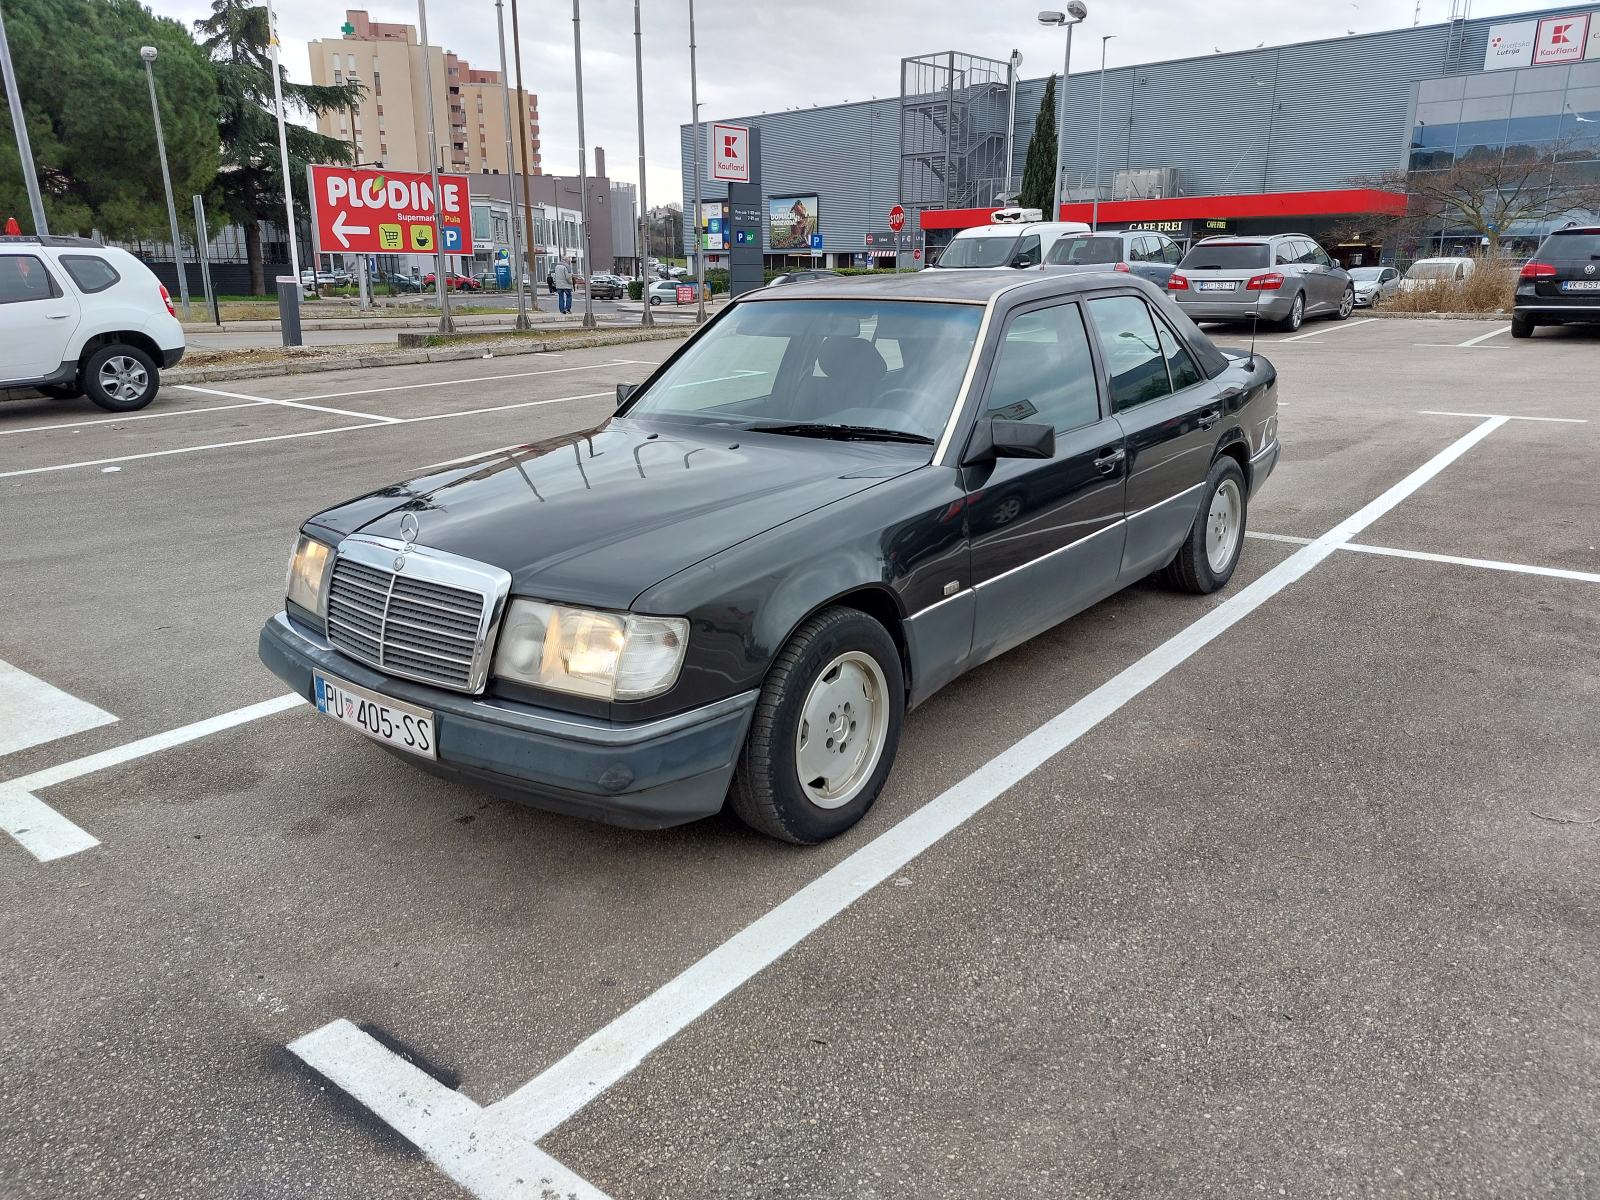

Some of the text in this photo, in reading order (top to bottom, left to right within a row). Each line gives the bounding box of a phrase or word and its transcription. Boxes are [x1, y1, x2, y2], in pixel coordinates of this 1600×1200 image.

[1499, 40, 1531, 50] Hrvatska
[1496, 48, 1520, 56] Lutrija
[1540, 46, 1578, 56] Kaufland
[717, 161, 745, 172] Kaufland
[327, 176, 460, 212] PLODINE
[444, 215, 461, 223] Pula
[890, 213, 904, 225] STOP
[1157, 221, 1183, 231] FREI
[446, 230, 457, 247] P
[813, 236, 820, 247] P
[1568, 281, 1578, 289] VK
[325, 683, 430, 751] PU 405-SS
